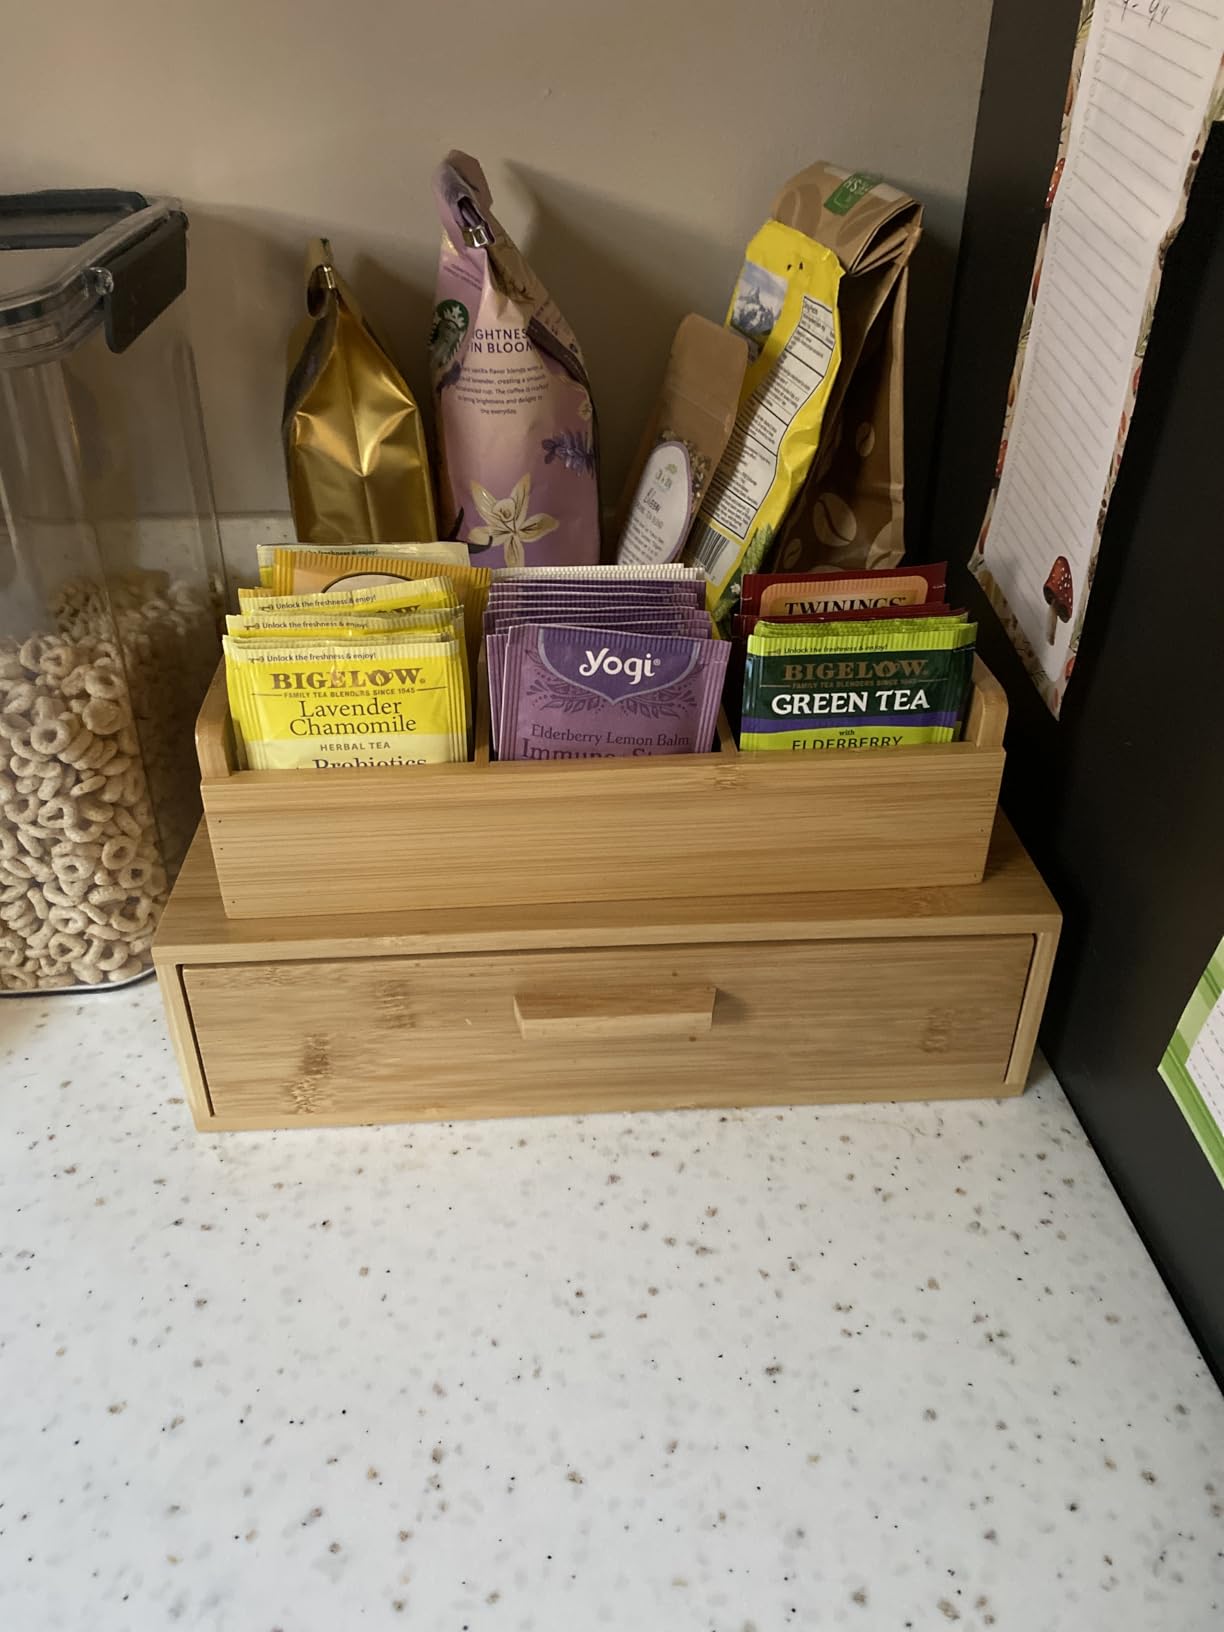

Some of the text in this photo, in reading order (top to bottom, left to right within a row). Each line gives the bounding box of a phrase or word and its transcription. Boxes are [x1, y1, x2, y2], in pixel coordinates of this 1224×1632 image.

[475, 329, 527, 339] GHTNES
[276, 602, 300, 610] Unlock
[302, 600, 314, 608] the
[314, 599, 347, 607] freshness
[355, 594, 376, 604] enjoy!
[266, 654, 292, 662] Unlock
[353, 652, 376, 660] enjoy!
[865, 644, 888, 652] enjoy!
[270, 668, 423, 690] BIGELOW
[783, 660, 928, 681] BIGELOW
[300, 698, 402, 718] Lavender
[771, 688, 930, 715] GREEN TEA
[289, 714, 417, 736] Chamomile
[531, 724, 689, 746] Elderberry Lemon Balm
[320, 742, 391, 752] HERBAL TEA
